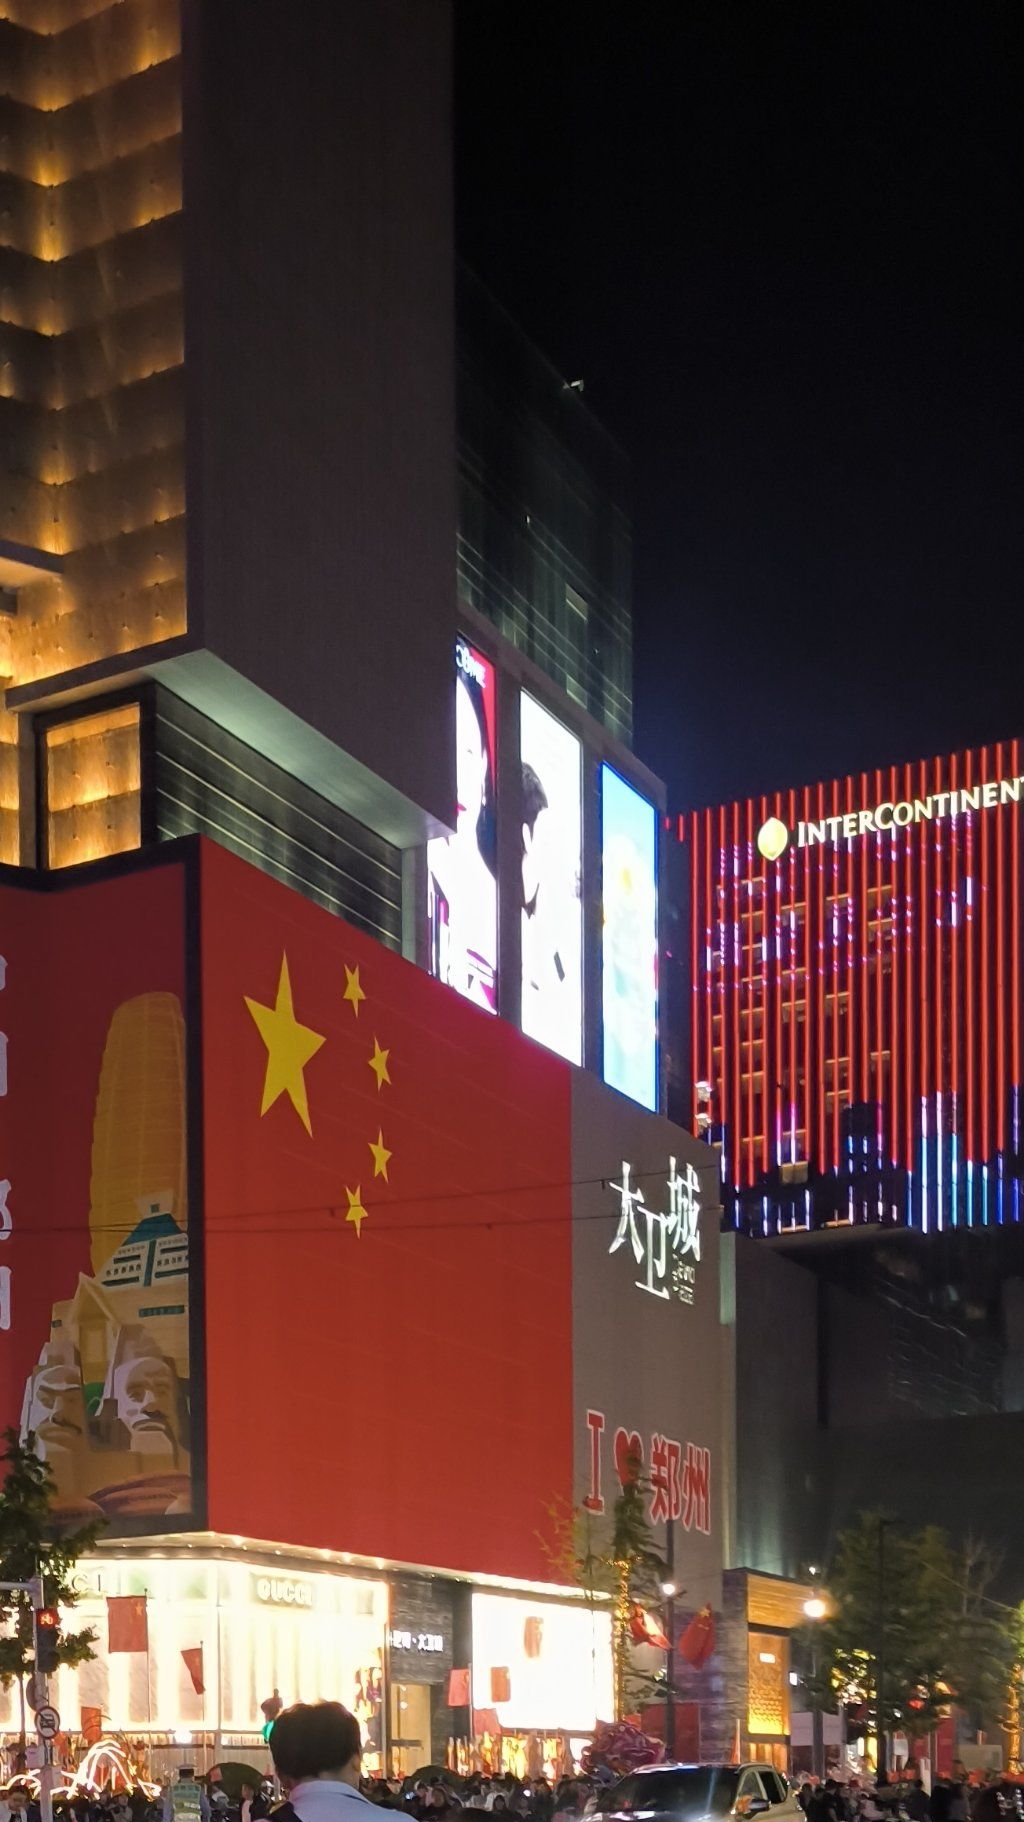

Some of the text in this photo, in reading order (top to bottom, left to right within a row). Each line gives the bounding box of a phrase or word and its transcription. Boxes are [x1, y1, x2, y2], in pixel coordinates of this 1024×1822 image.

[797, 777, 1024, 848] INTERCONTINEN
[608, 1155, 701, 1300] 大卫城
[582, 1409, 712, 1536] I 郑州
